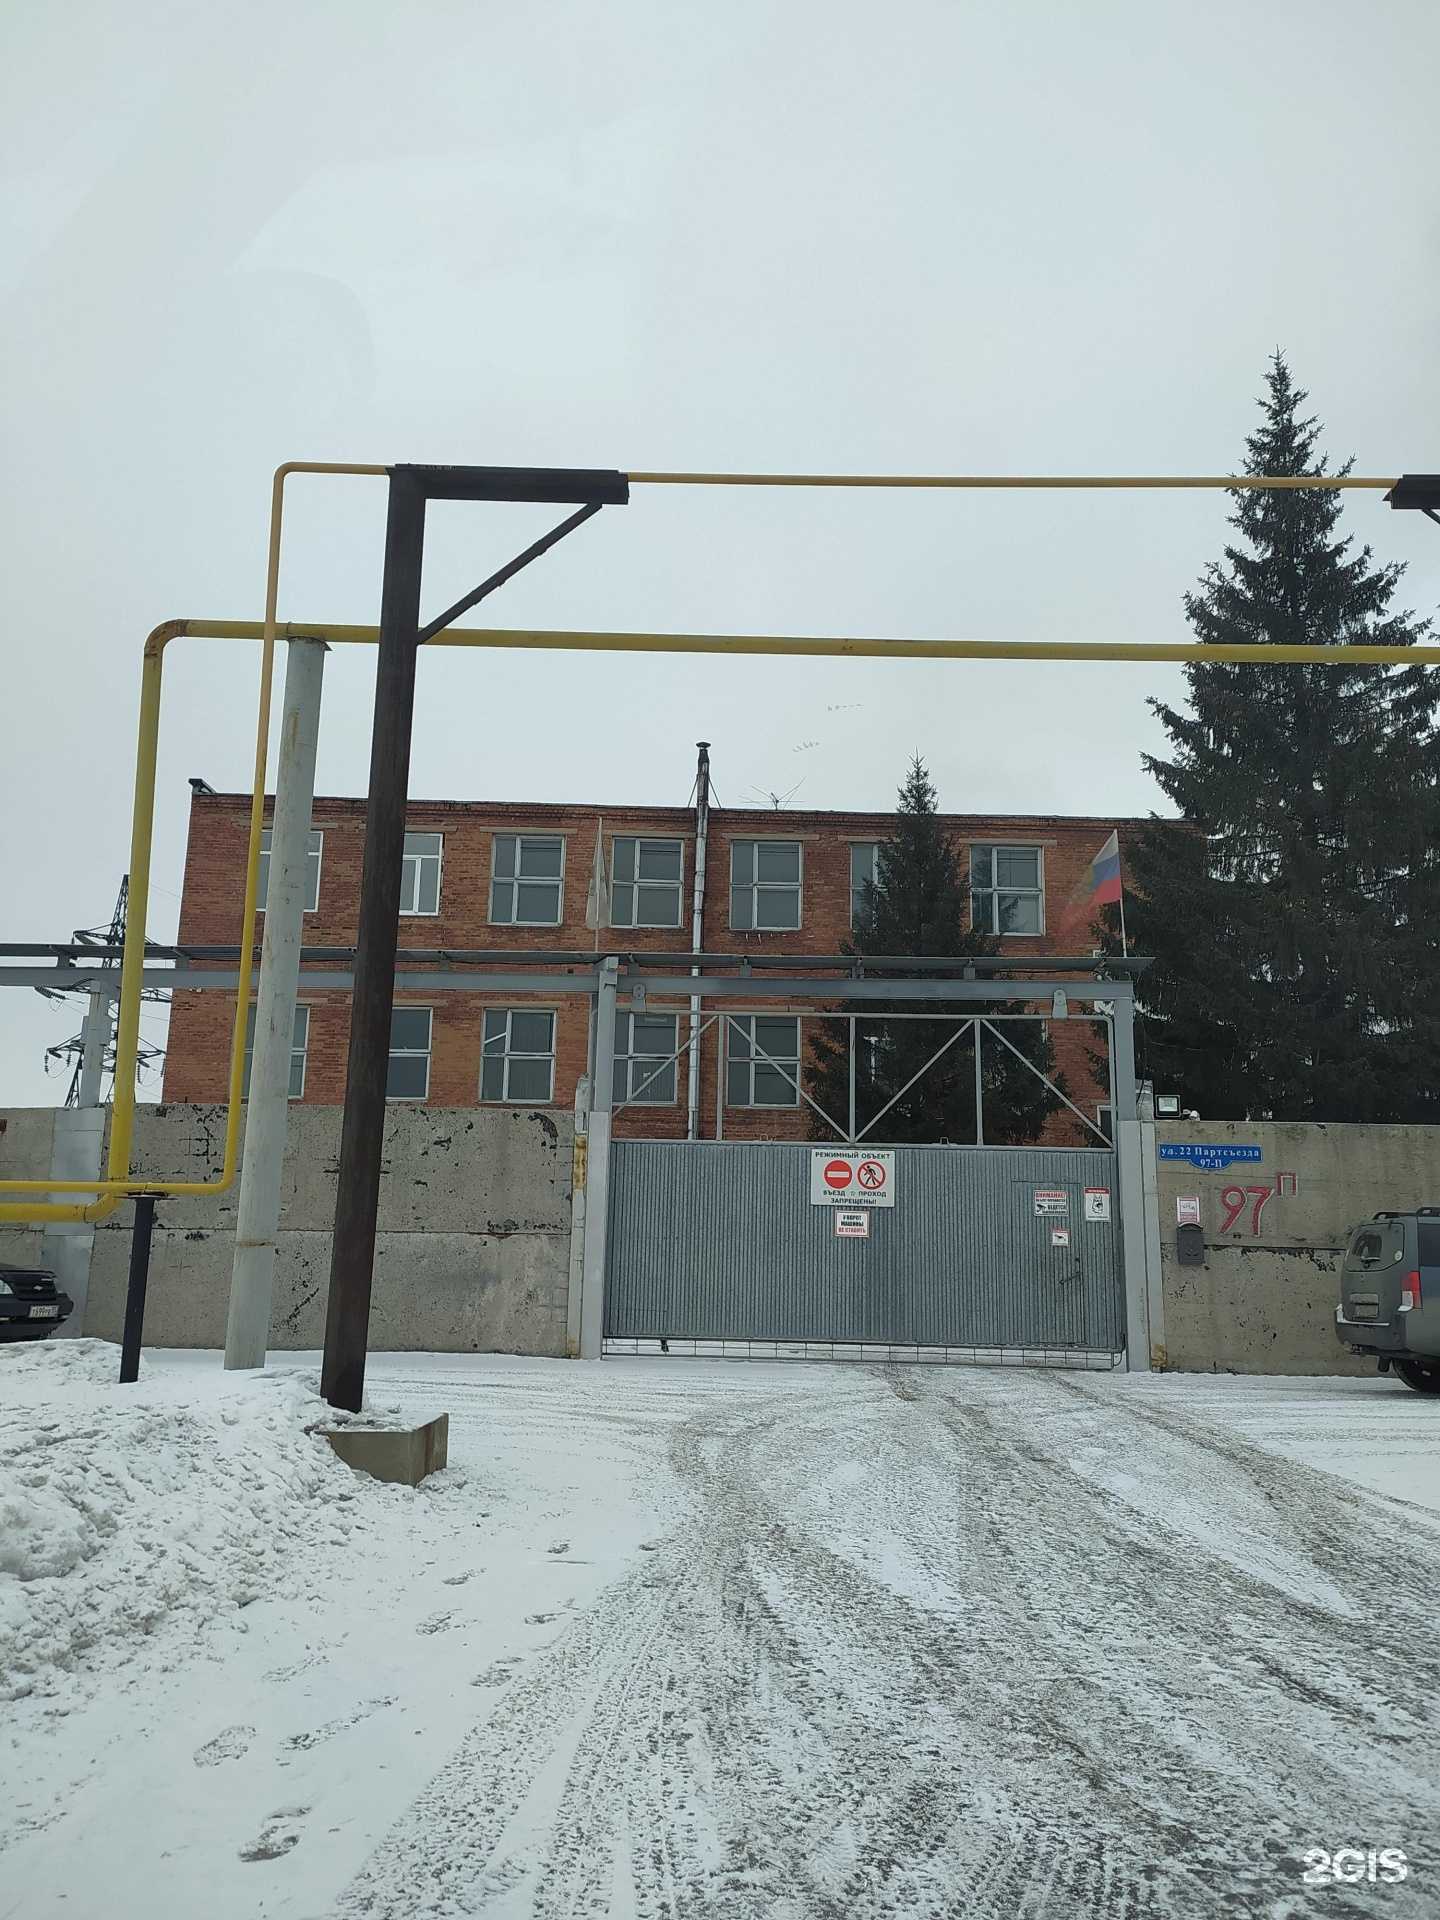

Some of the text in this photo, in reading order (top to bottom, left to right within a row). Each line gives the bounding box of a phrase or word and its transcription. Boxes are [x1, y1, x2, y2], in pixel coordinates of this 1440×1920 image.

[815, 1151, 859, 1159] РЕЖИМНЫЙ
[1194, 1147, 1259, 1158] Партсъезда
[1200, 1159, 1222, 1169] 97-П
[823, 1189, 846, 1197] ВЪЕЗД
[858, 1190, 887, 1198] ПРОХОД
